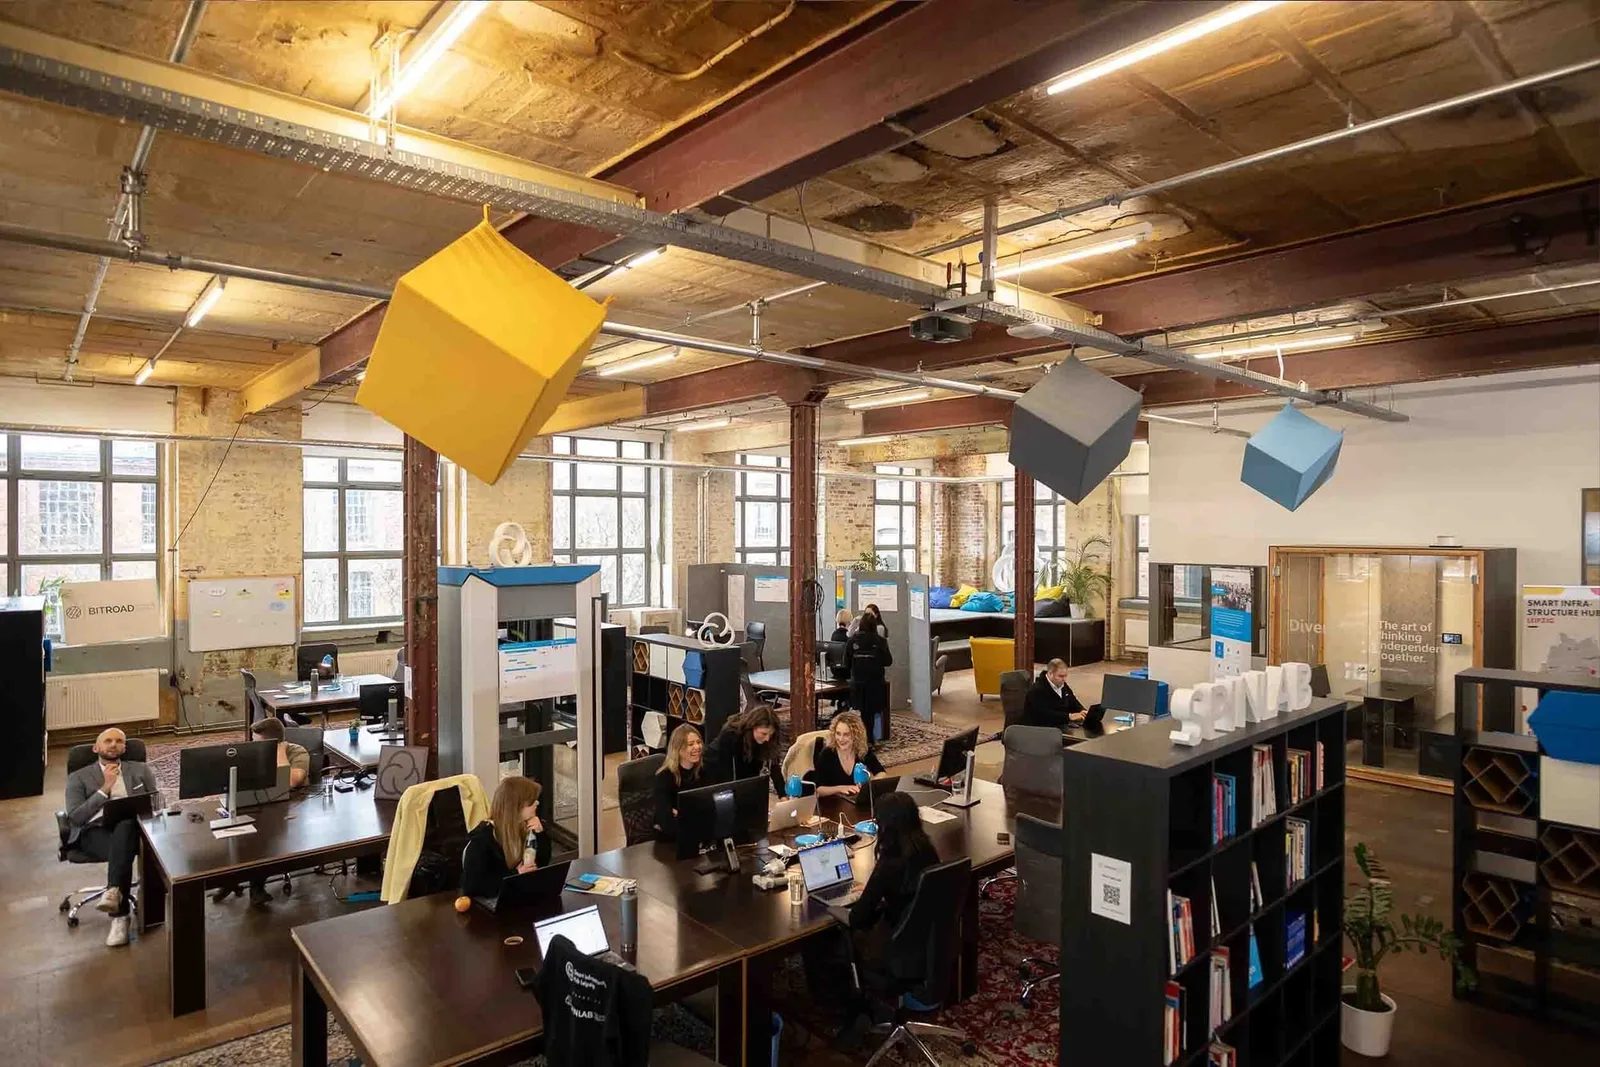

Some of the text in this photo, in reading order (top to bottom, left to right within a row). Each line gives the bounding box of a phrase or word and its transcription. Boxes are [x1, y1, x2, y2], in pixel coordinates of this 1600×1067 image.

[1527, 599, 1593, 607] SMART INFRA-
[88, 604, 135, 615] BITROAD
[1527, 608, 1579, 617] STRUCTURE
[1379, 620, 1432, 632] The art of
[1379, 630, 1422, 644] hinking
[1379, 641, 1443, 654] ndependen
[1380, 652, 1428, 663] ogether.
